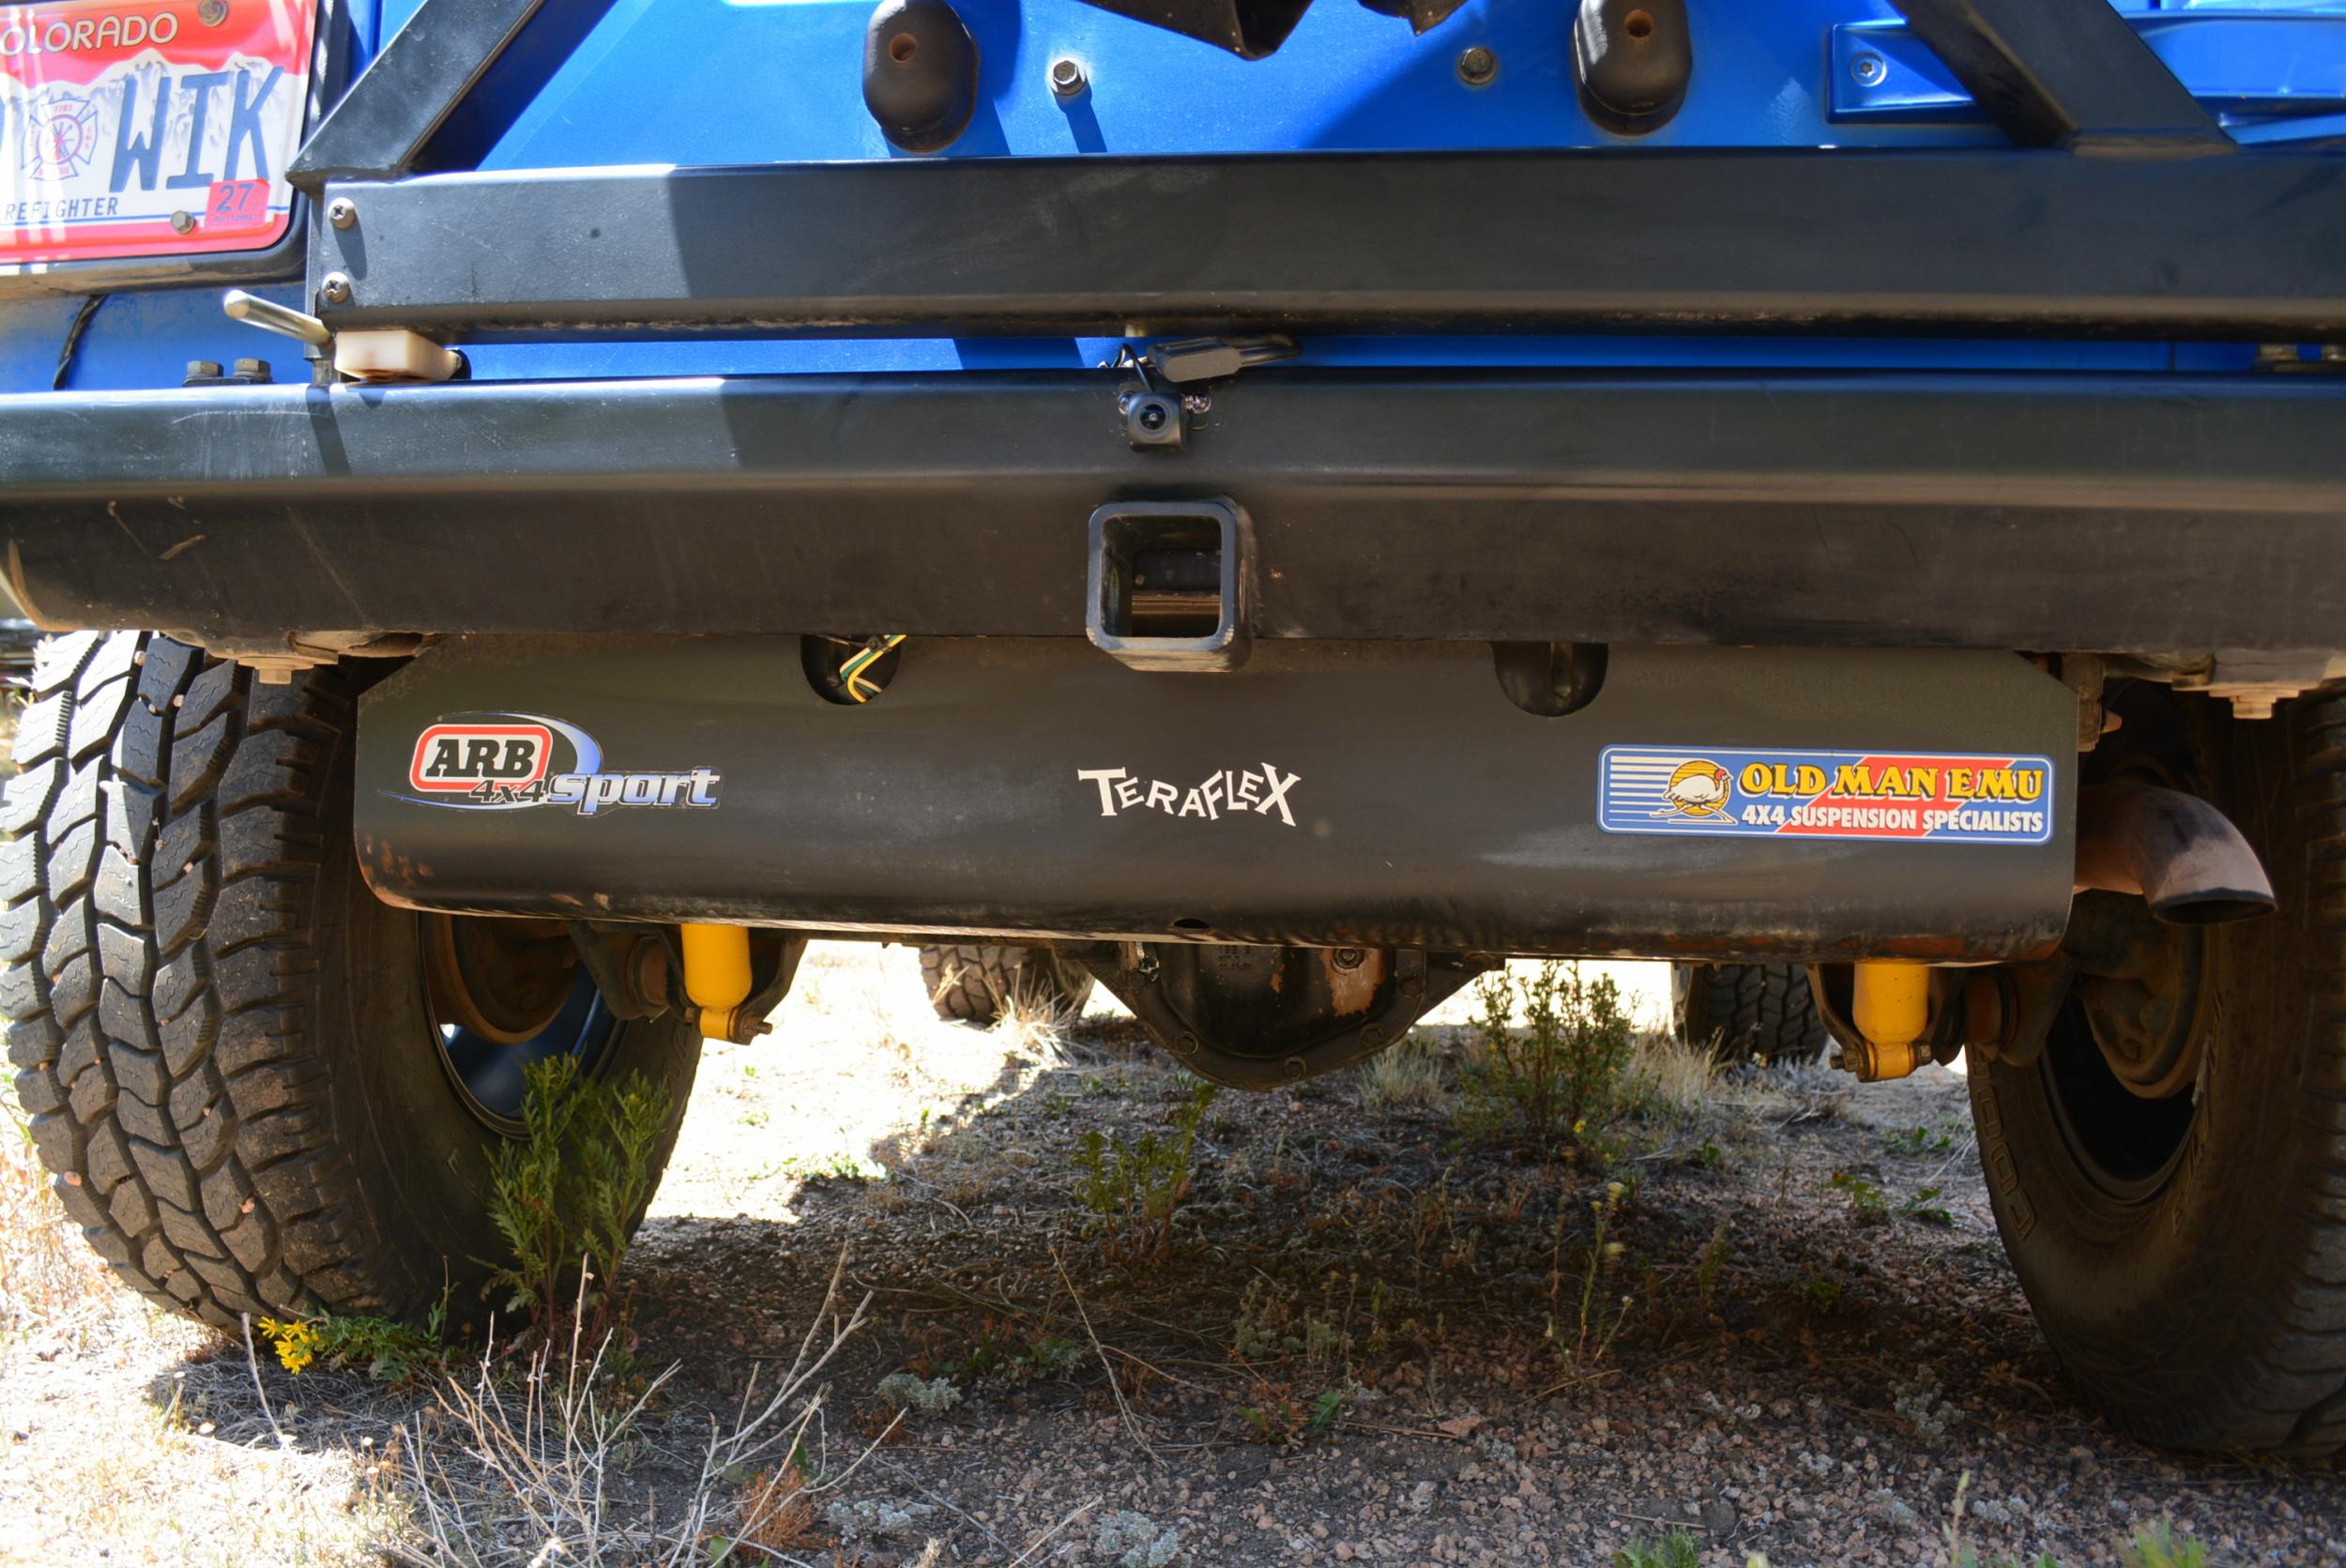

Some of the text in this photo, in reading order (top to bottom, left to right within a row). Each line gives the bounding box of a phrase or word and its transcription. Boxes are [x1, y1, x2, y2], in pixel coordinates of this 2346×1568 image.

[109, 66, 285, 193] WIK
[216, 182, 255, 212] 27
[425, 738, 536, 778] ARB
[469, 769, 721, 814] 4x4 sport
[1077, 762, 1302, 827] TERAFLEX
[1737, 761, 2044, 805] OLD MAN EMU
[1741, 804, 2044, 833] 4X4 SUSPENSION SPECIALISTS
